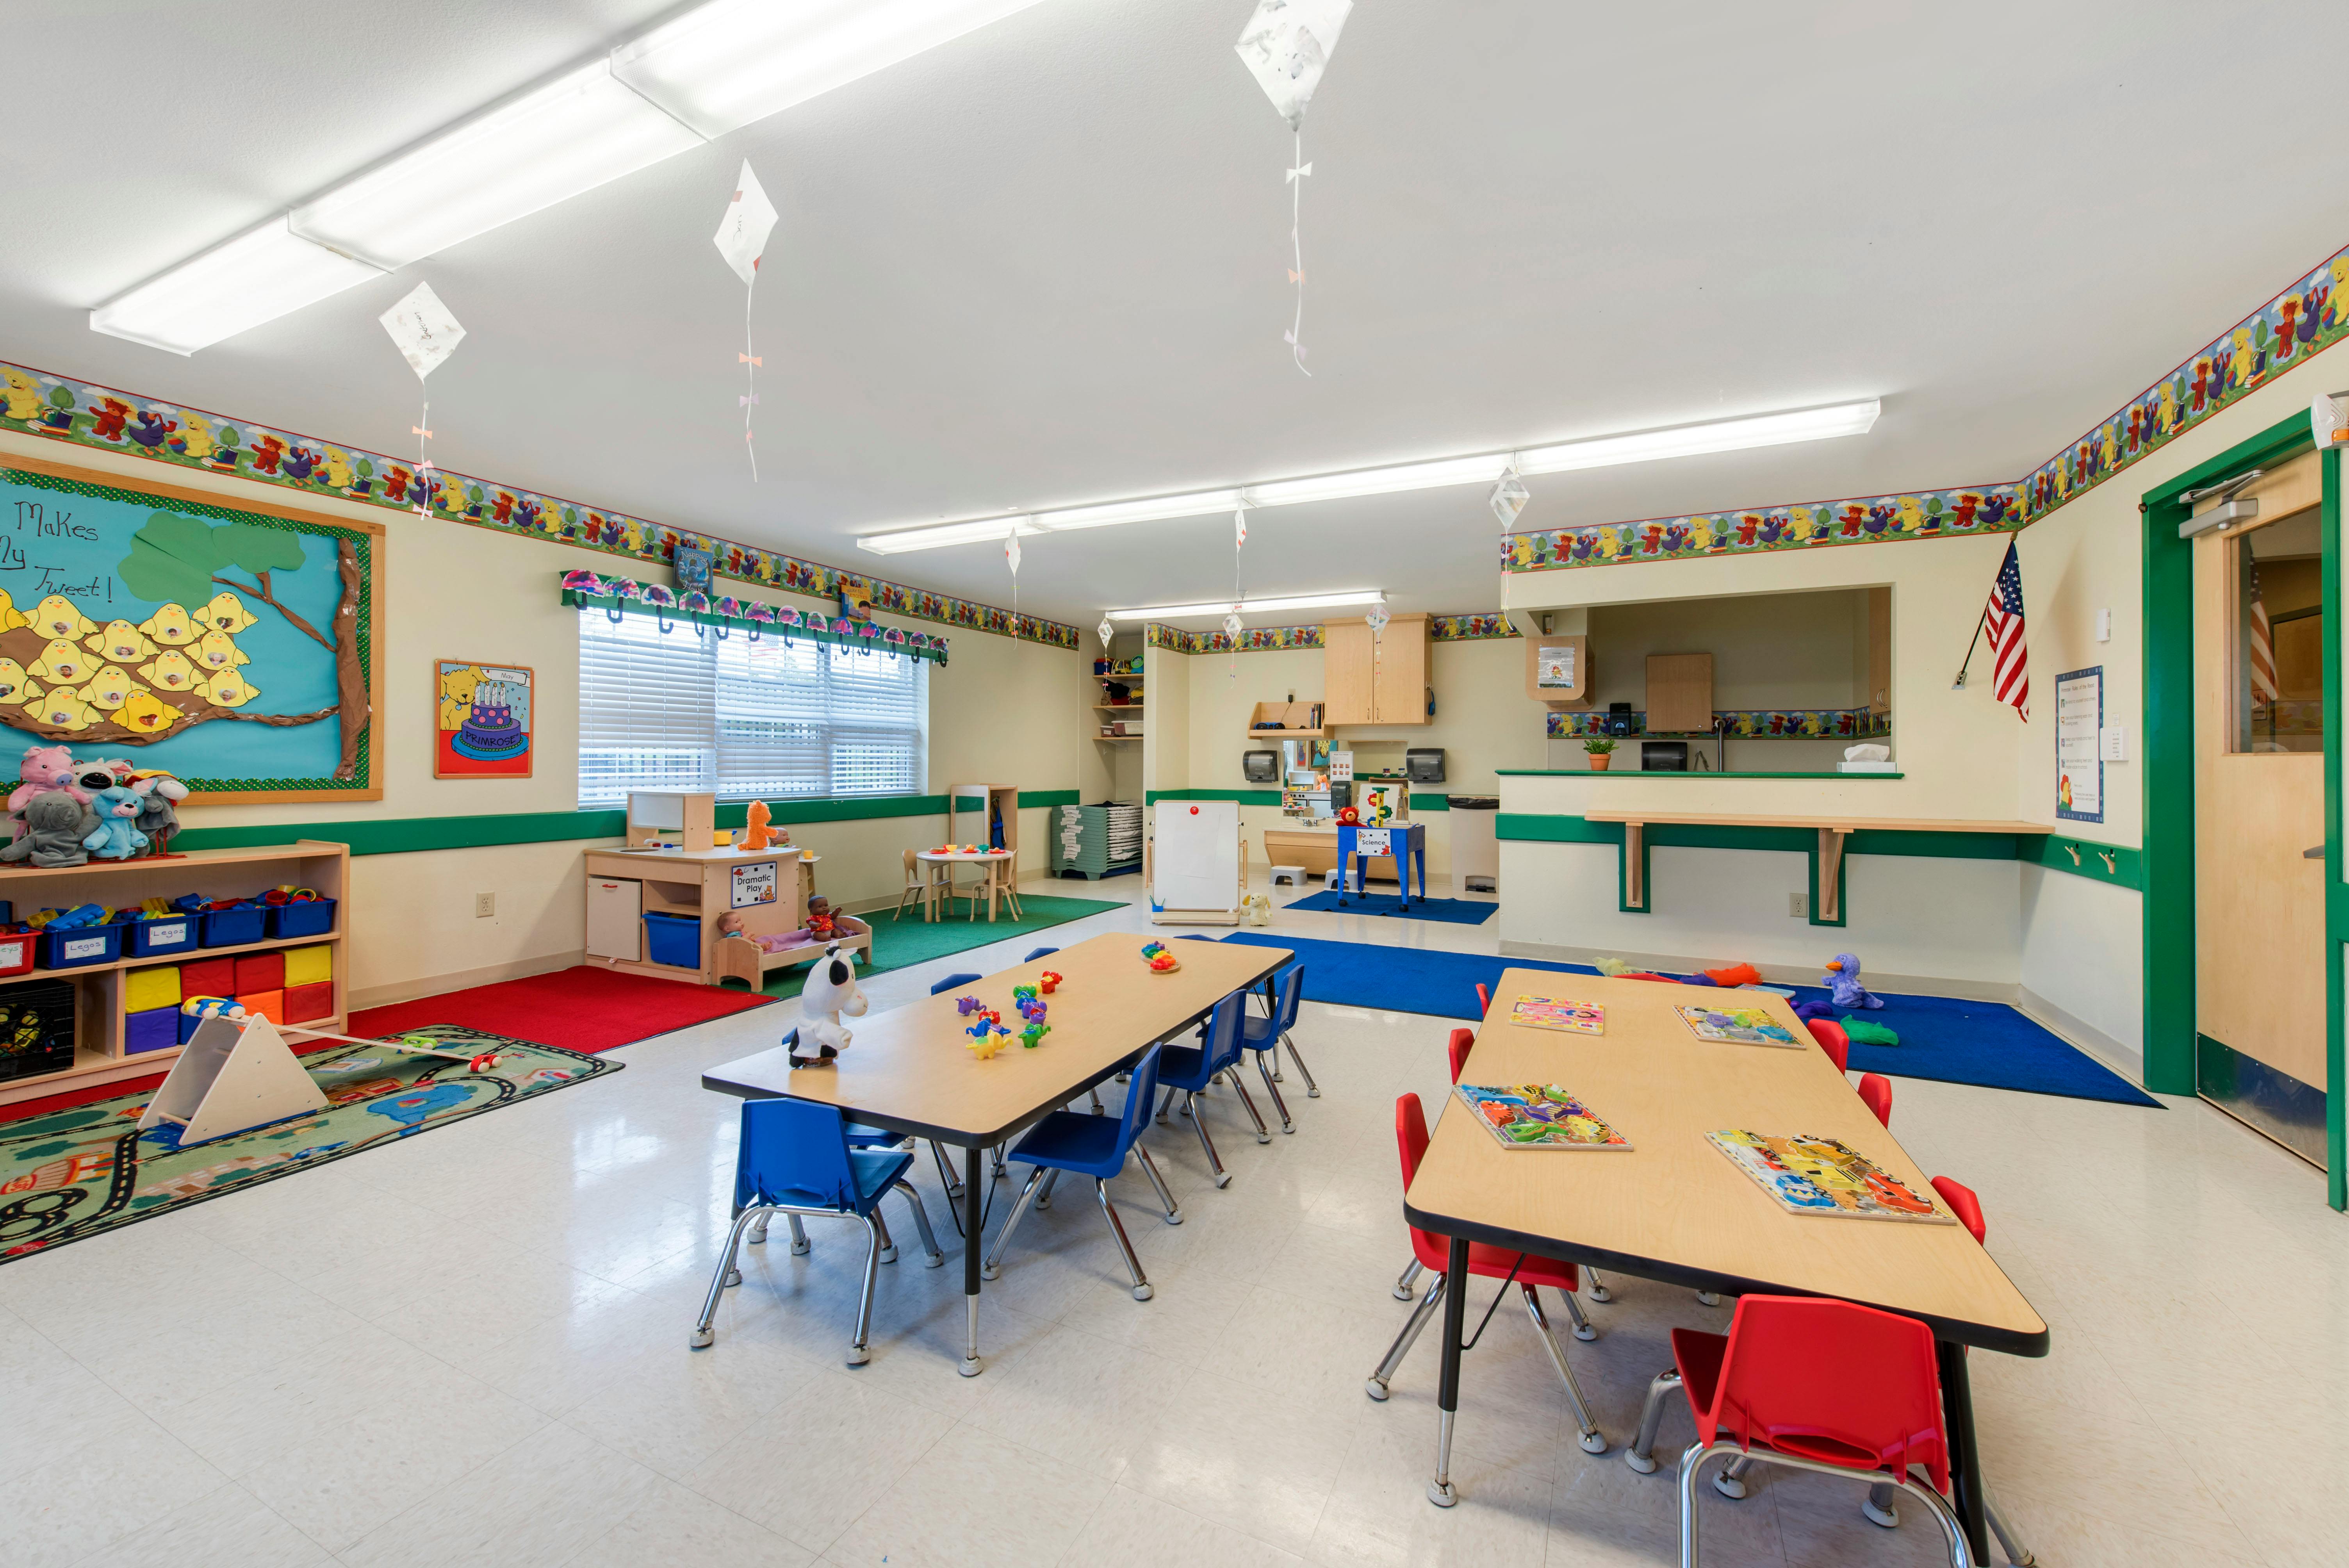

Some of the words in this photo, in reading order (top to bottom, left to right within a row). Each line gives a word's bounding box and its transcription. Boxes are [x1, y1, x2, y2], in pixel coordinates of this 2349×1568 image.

[14, 501, 98, 541] Makes
[681, 549, 708, 565] Napping
[682, 582, 704, 592] House
[738, 874, 771, 885] Dramatic
[153, 928, 184, 937] Legos
[70, 941, 101, 951] Legos
